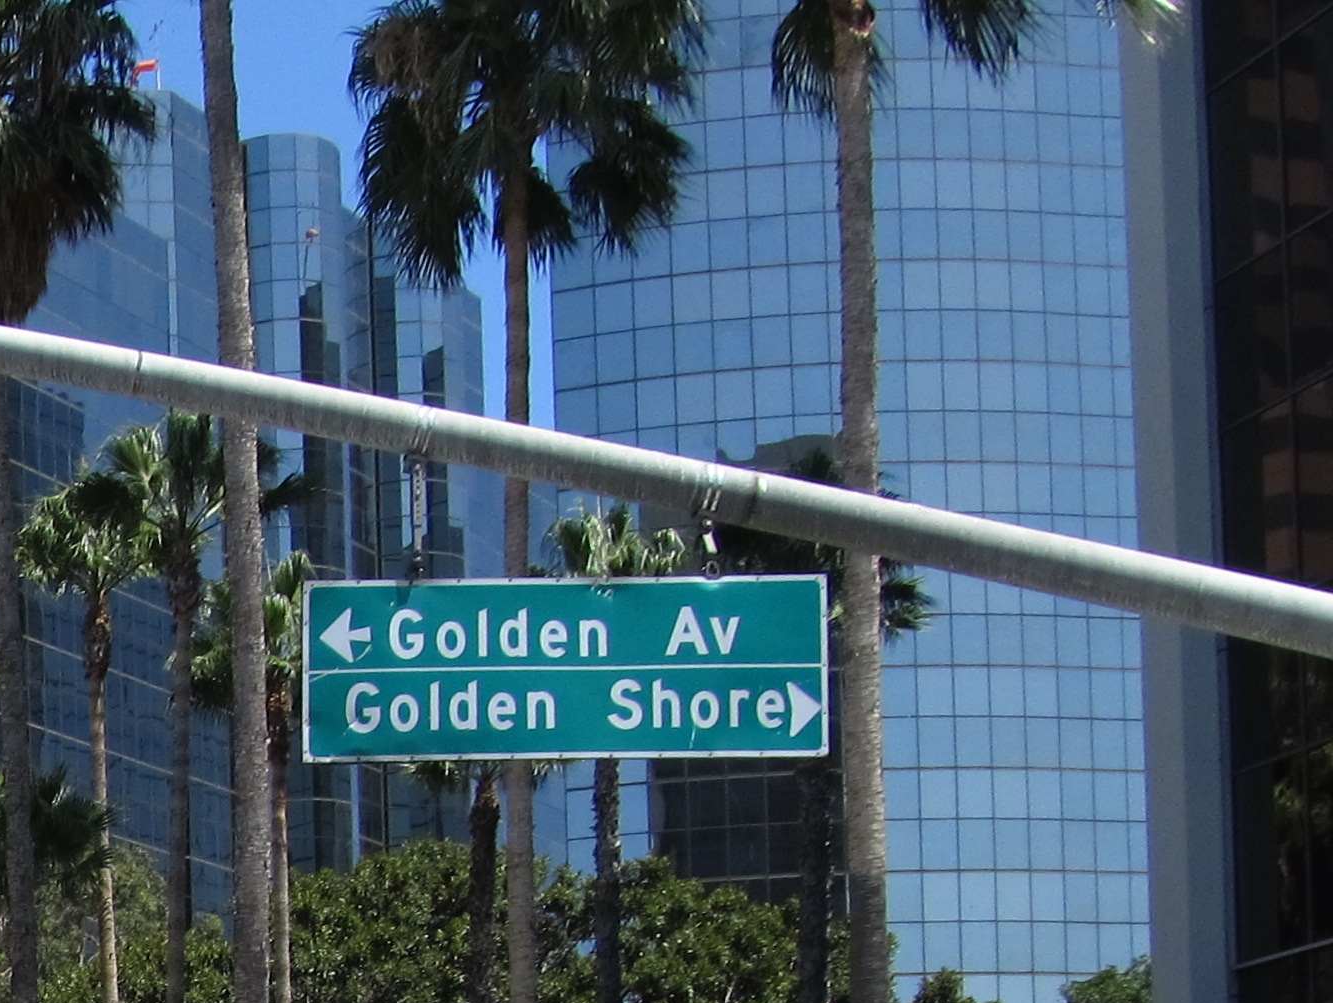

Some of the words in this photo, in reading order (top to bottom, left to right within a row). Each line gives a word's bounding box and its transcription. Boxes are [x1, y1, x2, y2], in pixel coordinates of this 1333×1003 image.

[389, 607, 609, 659] Golden
[665, 605, 742, 656] Av
[345, 680, 556, 734] Golden
[607, 678, 786, 731] Shore
